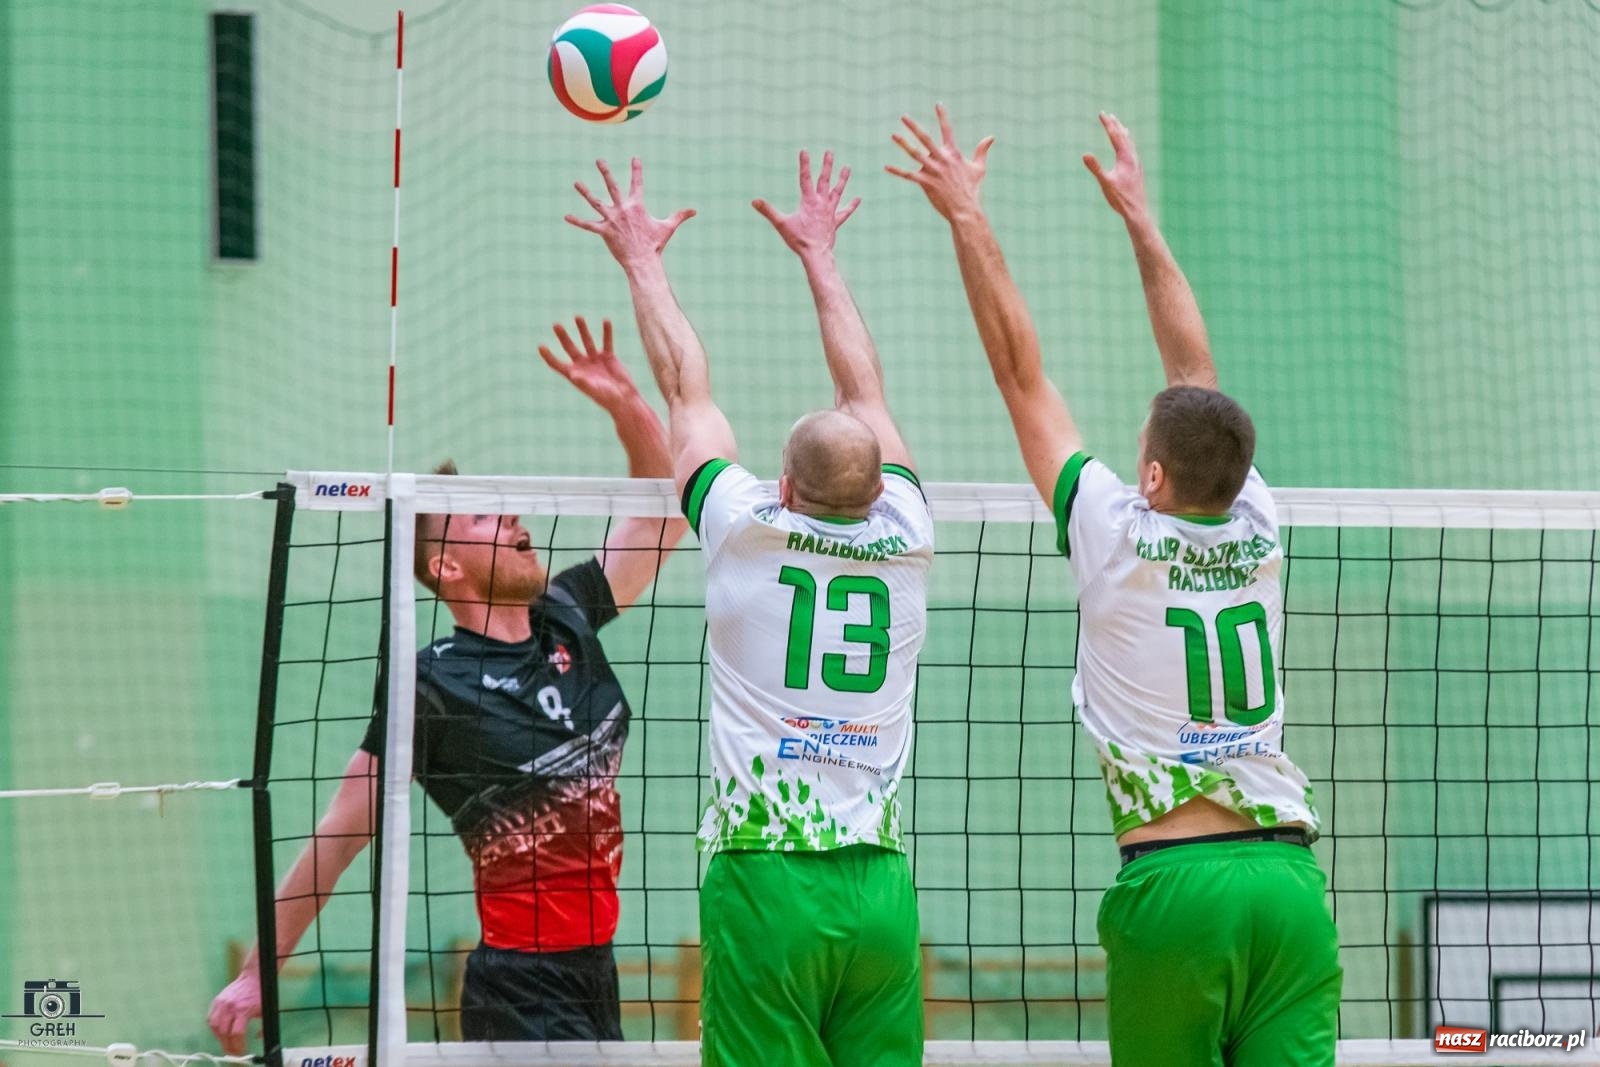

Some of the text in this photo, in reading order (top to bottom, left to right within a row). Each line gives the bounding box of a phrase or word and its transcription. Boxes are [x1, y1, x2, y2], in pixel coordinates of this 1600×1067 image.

[315, 483, 371, 496] netex
[778, 565, 891, 693] 13
[1165, 601, 1276, 726] 10
[840, 724, 879, 734] MULTI
[806, 733, 878, 747] PIECZENIA
[301, 1055, 356, 1067] netex
